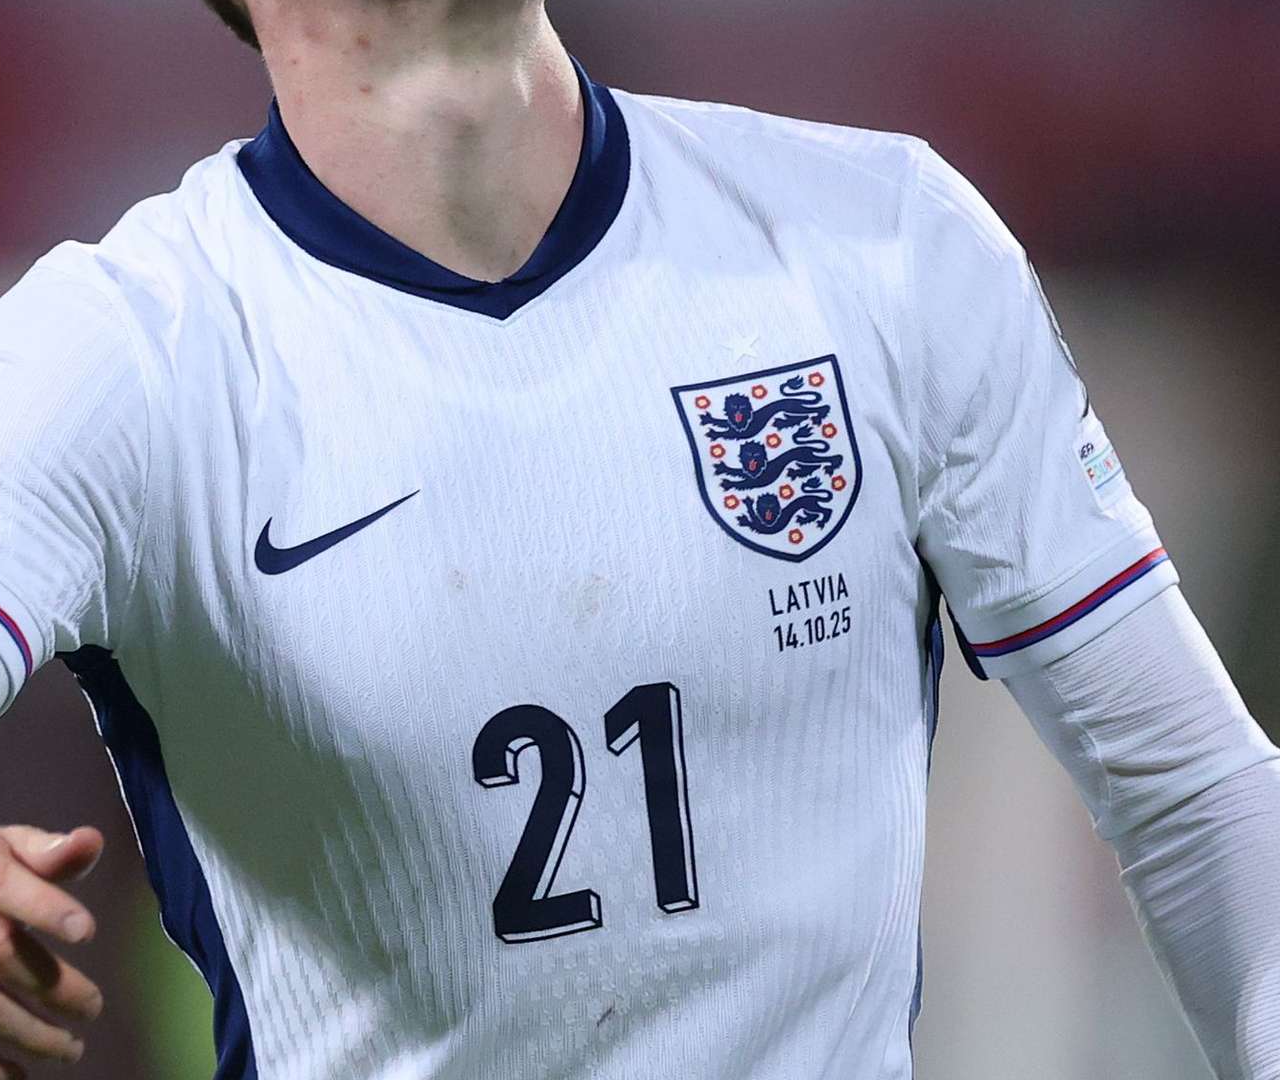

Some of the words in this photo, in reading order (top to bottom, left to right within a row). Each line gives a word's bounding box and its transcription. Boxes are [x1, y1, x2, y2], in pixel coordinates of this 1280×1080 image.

[768, 572, 849, 617] LATVIA
[773, 605, 852, 653] 14.10.25
[472, 681, 700, 944] 21
